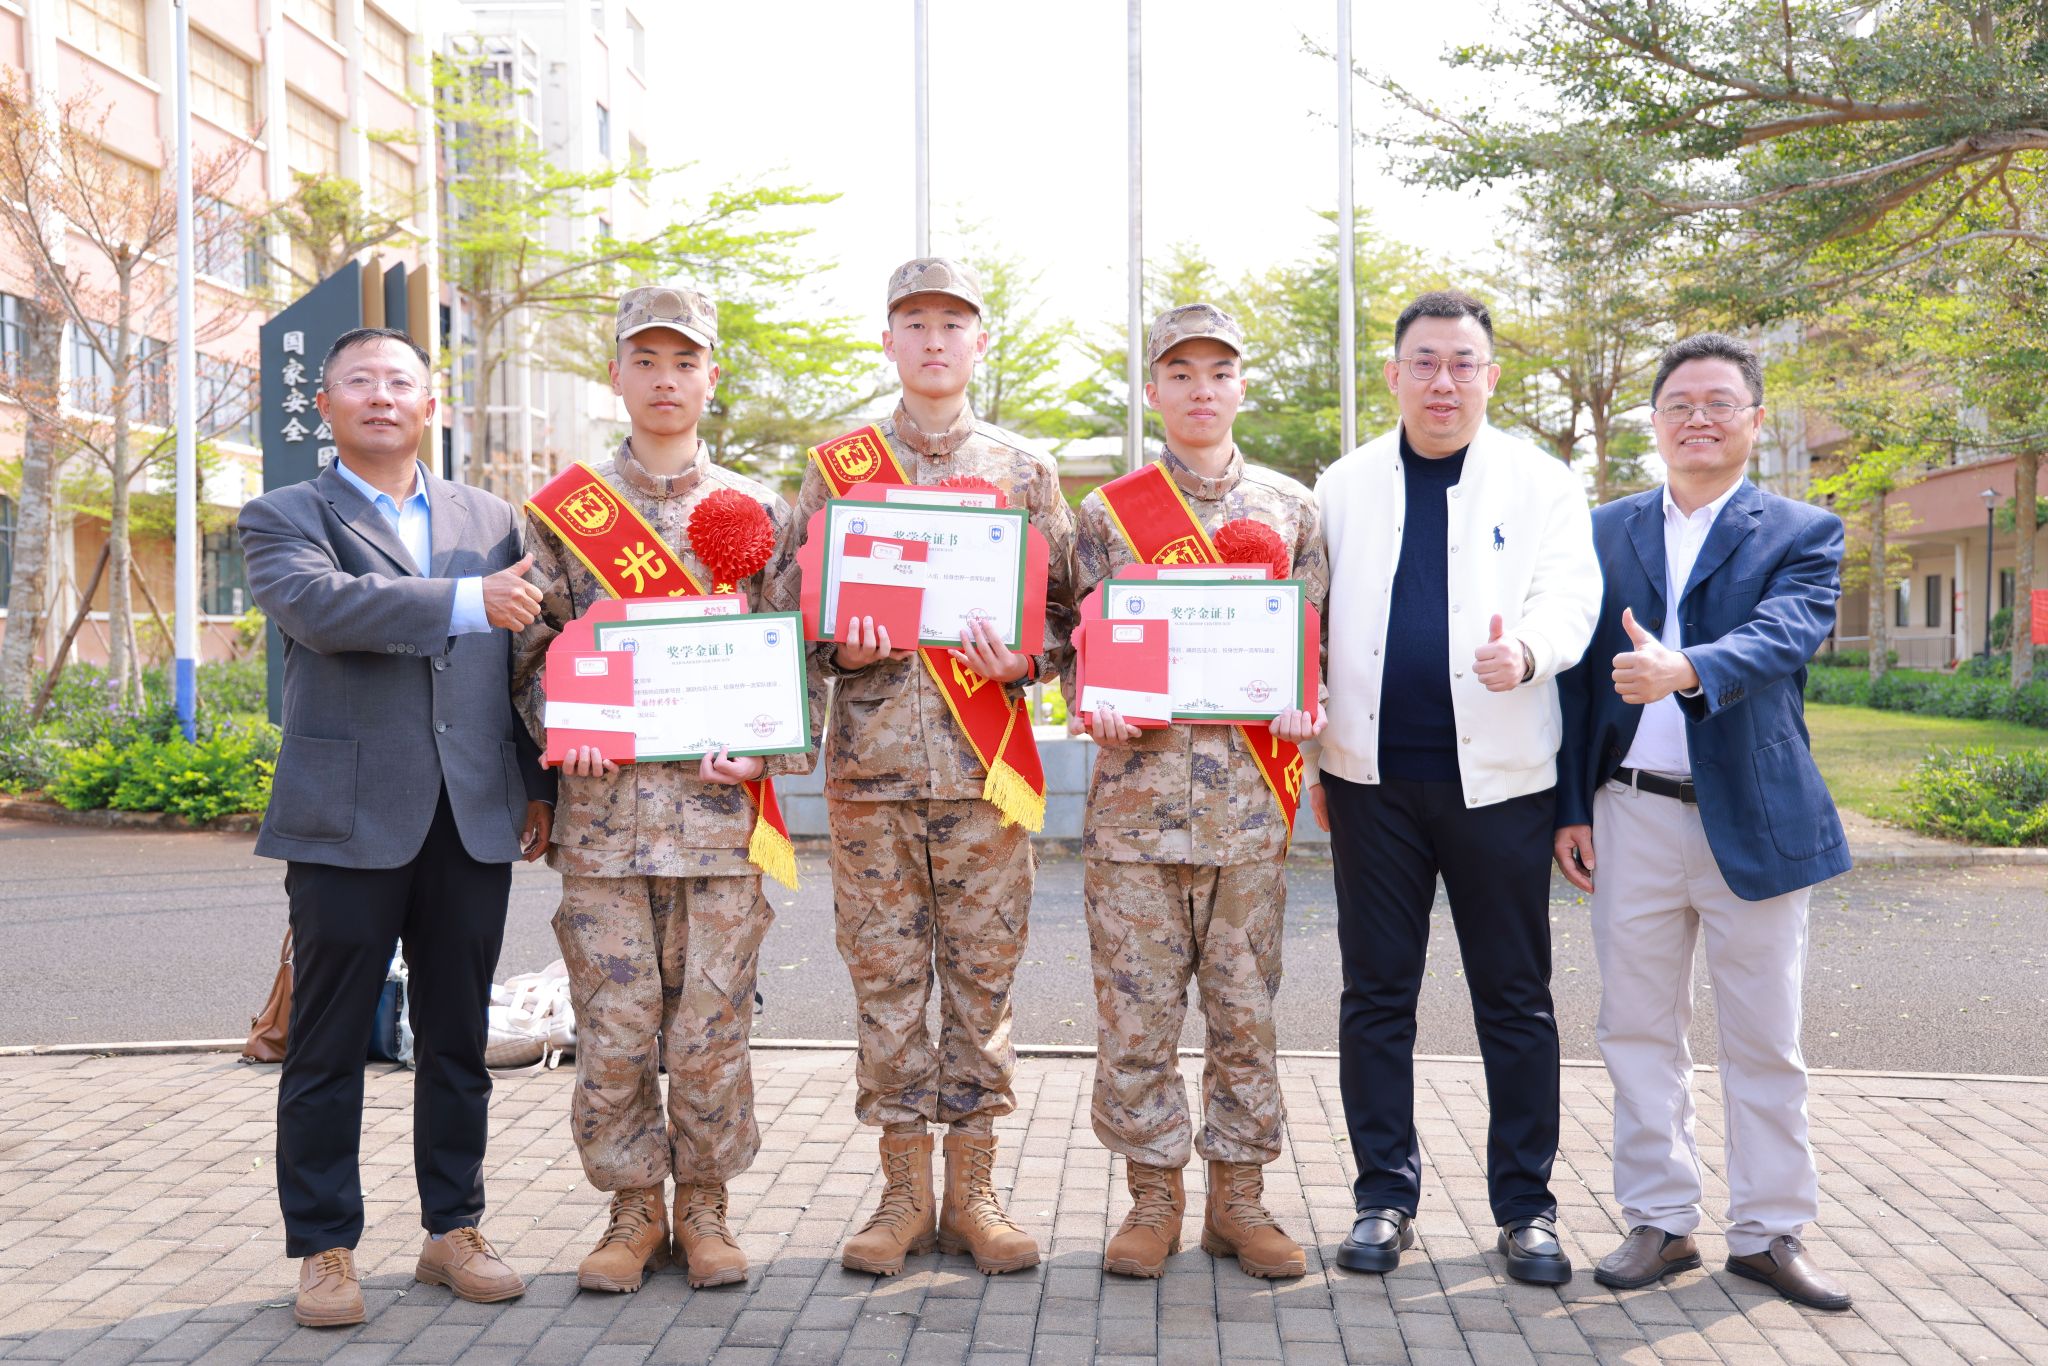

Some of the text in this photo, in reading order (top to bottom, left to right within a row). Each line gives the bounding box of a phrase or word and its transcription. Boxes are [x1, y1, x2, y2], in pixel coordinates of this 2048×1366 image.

[281, 331, 310, 442] 国家安全
[613, 541, 686, 597] 光
[714, 582, 737, 595] 光
[1170, 606, 1236, 619] 奖学金证书
[667, 642, 734, 659] 奖学金证书
